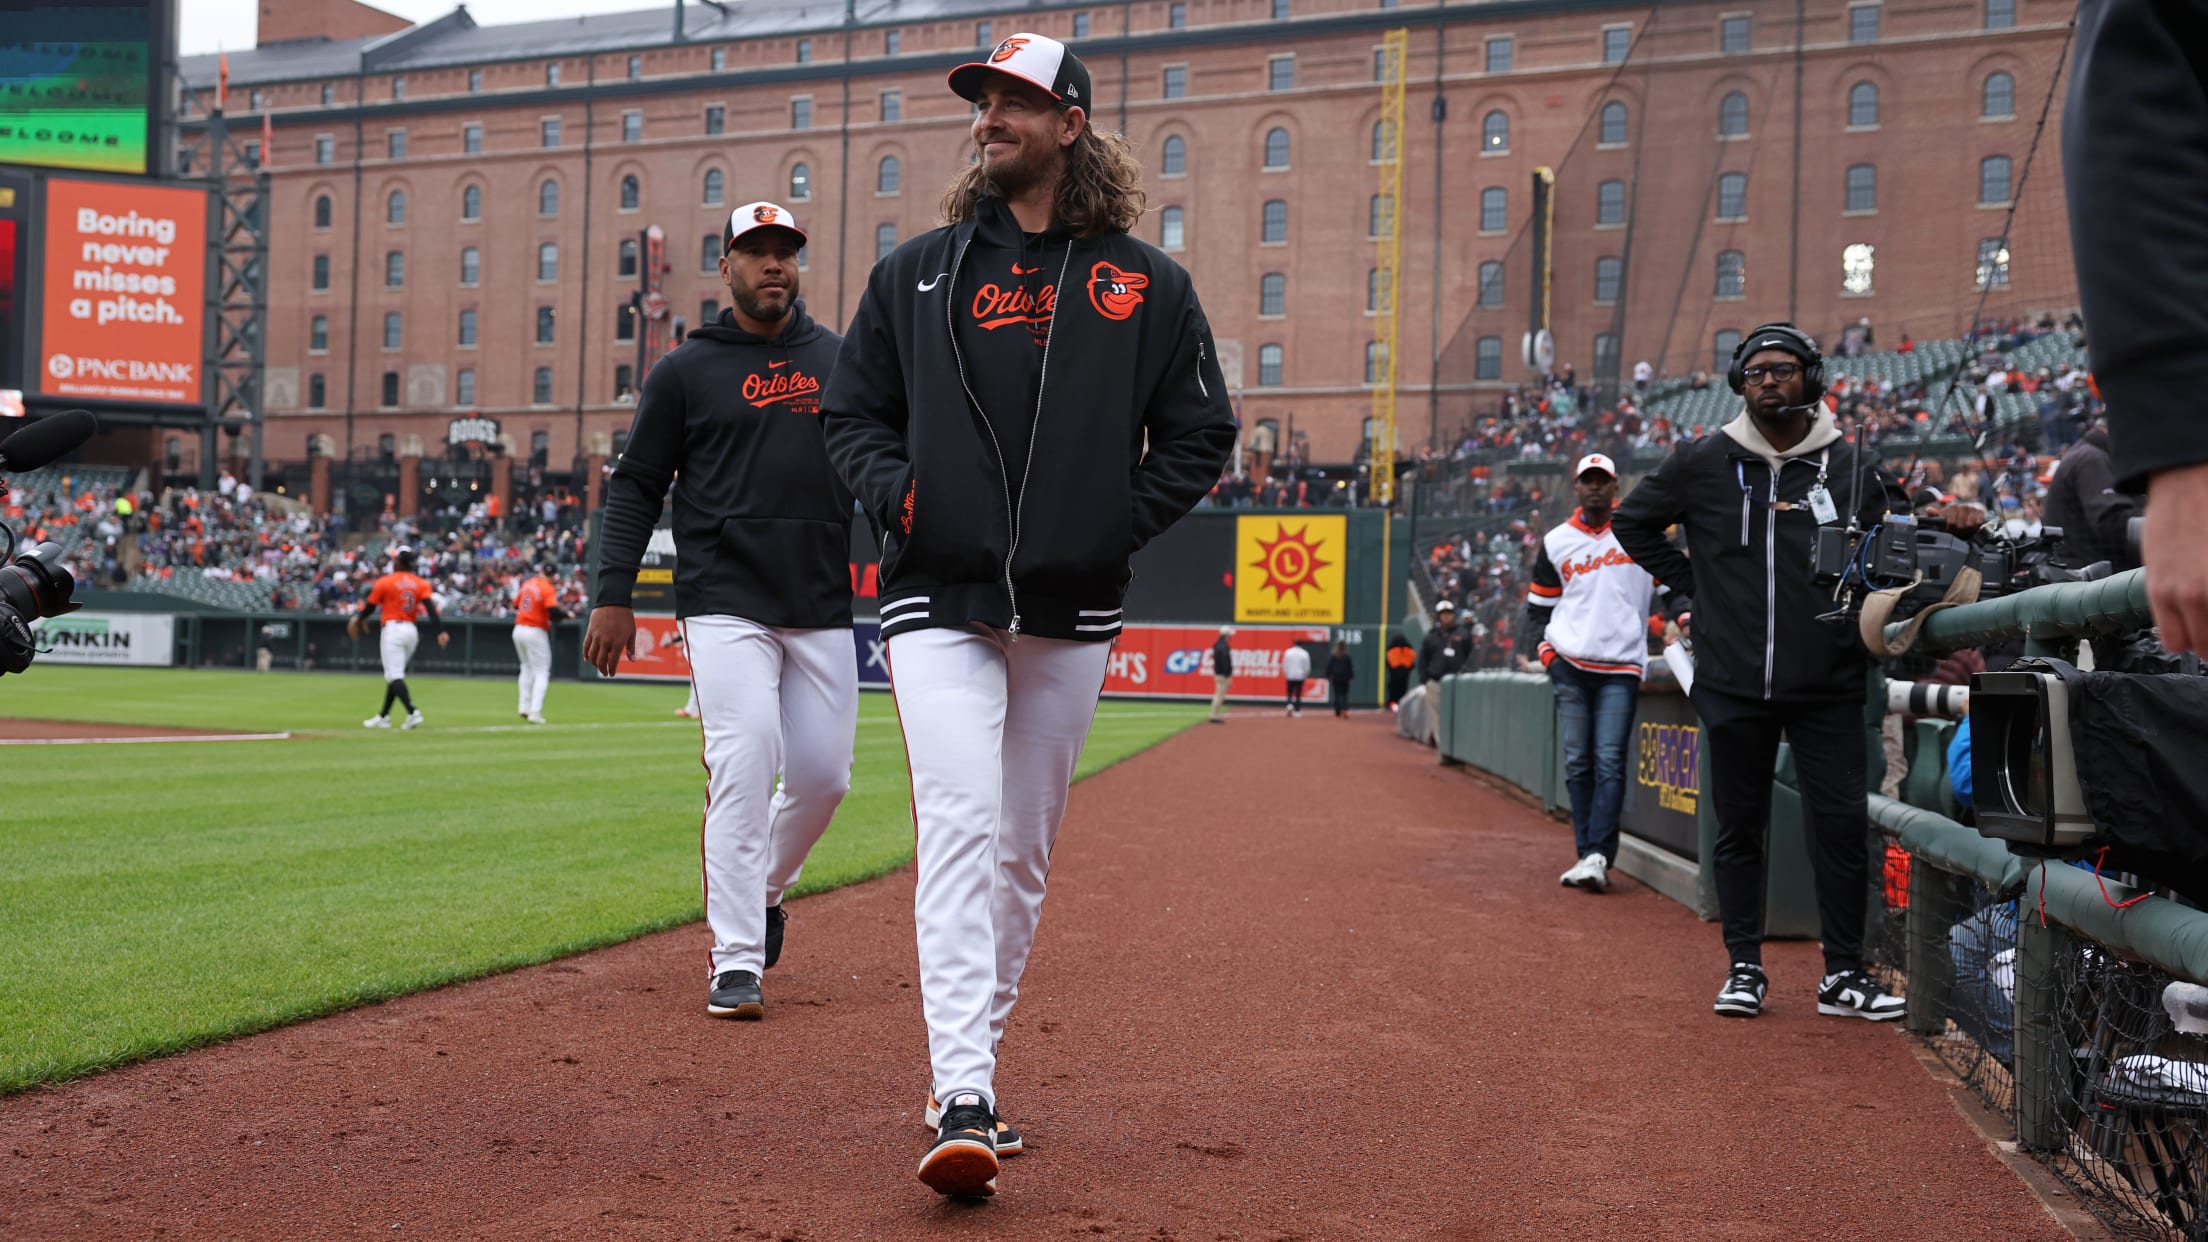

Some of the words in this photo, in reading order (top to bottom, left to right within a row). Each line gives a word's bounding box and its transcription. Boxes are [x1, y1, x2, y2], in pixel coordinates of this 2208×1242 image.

[77, 208, 176, 244] Boring
[83, 242, 170, 267] never
[73, 265, 176, 296] misses
[69, 299, 92, 319] a
[98, 295, 184, 325] pitch.
[972, 284, 1056, 326] Oriole
[76, 357, 127, 380] PNC
[128, 359, 193, 383] BANK
[742, 371, 819, 406] Orioles
[400, 591, 415, 612] 3
[521, 592, 533, 612] 6
[11, 615, 31, 643] Canon
[1201, 648, 1284, 667] CRROLL
